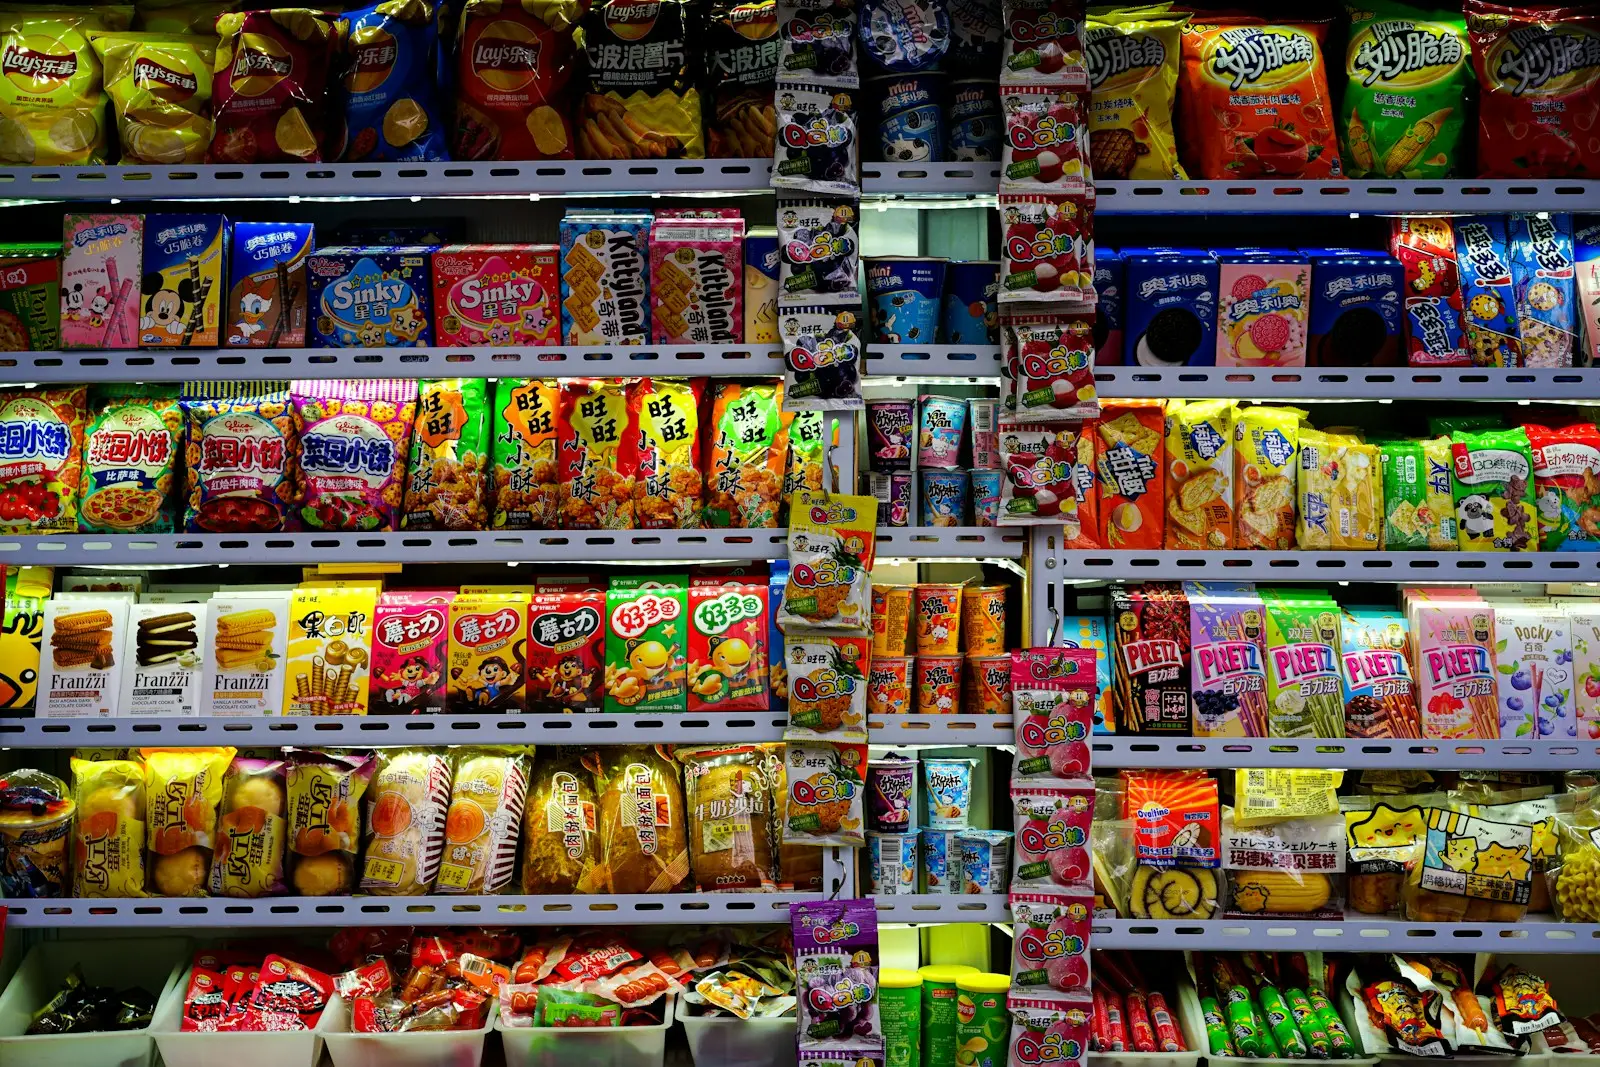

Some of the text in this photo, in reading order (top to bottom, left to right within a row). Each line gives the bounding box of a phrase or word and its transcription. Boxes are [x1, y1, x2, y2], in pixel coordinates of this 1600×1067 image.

[1220, 27, 1264, 46] BUGLES
[1373, 22, 1416, 40] BUGLES
[3, 49, 77, 76] Lay's 乐事
[475, 44, 511, 64] Lay's
[585, 42, 685, 70] 大波浪薯片
[1217, 33, 1313, 89] 妙脆角
[1356, 33, 1461, 88] 妙脆角
[888, 80, 918, 97] mini
[76, 223, 128, 246] 奥利奥
[155, 223, 209, 246] 奥利奥
[164, 235, 204, 255] 巧脆卷
[244, 230, 299, 253] 奥利奥
[1008, 233, 1075, 262] QQ糖
[253, 242, 294, 262] 巧脆卷
[786, 237, 852, 264] QQ糖
[333, 281, 404, 310] Sinky
[460, 280, 535, 308] Sinky
[607, 235, 648, 337] Kittyland
[1137, 273, 1209, 300] 奥利奥
[1322, 273, 1394, 299] 奥利奥
[29, 287, 49, 325] Pop
[354, 302, 388, 320] 星奇
[482, 301, 518, 319] 星奇
[697, 254, 738, 345] Kittyland
[1229, 295, 1301, 322] 奥利奥
[789, 345, 855, 372] QQ糖
[1024, 350, 1088, 380] QQ糖
[422, 390, 452, 437] 旺旺
[515, 386, 554, 436] 旺旺
[580, 394, 618, 444] 旺旺
[648, 394, 690, 443] 旺旺
[731, 400, 766, 444] 旺旺
[90, 431, 169, 464] 菜园小饼
[203, 436, 286, 471] 菜园小饼
[303, 435, 394, 474] 菜园小饼
[1191, 424, 1217, 459] 闲趣
[1263, 432, 1287, 465] 闲趣
[498, 423, 539, 495] 小小酥
[563, 430, 601, 503] 小小酥
[637, 430, 676, 500] 小小酥
[713, 431, 746, 496] 小小酥
[1137, 455, 1155, 483] Tiki
[1547, 453, 1600, 469] 动物饼干
[105, 470, 140, 482] 比萨味
[210, 478, 260, 491] 红烩牛肉味
[316, 477, 364, 490] 孜然烧烤味
[1011, 461, 1072, 488] QQ糖
[810, 507, 857, 524] QQ糖
[809, 544, 830, 554] 旺仔
[793, 563, 856, 588] QQ糖
[297, 611, 367, 639] 黑白配
[616, 598, 676, 634] 好多鱼
[698, 595, 758, 630] 好多鱼
[384, 612, 440, 644] 蘑古力
[460, 611, 515, 643] 蘑古力
[538, 611, 595, 643] 蘑古力
[1288, 628, 1313, 640] 双层
[1441, 629, 1467, 642] 双层
[807, 654, 827, 664] 旺仔
[1124, 642, 1179, 671] PRETZ
[1524, 642, 1544, 653] 百奇
[1199, 646, 1260, 679] PRETZ
[1275, 646, 1336, 679] PRETZ
[1346, 651, 1407, 683] PRETZ
[1429, 647, 1490, 683] PRETZ
[51, 673, 106, 690] Franzzi
[134, 671, 189, 688] Franzzi
[214, 673, 269, 690] Franzzi
[794, 676, 856, 701] QQ糖
[1147, 668, 1180, 684] 百力滋
[1222, 678, 1260, 696] 百力滋
[1299, 680, 1338, 697] 百力滋
[1164, 694, 1185, 704] 十三香
[1372, 681, 1410, 698] 百力滋
[1453, 680, 1492, 699] 百力滋
[1034, 700, 1055, 709] 旺仔
[1144, 689, 1160, 722] 夜宵
[1164, 704, 1186, 714] 小龙虾
[1022, 720, 1086, 748] QQ糖
[806, 759, 827, 768] 旺仔
[793, 779, 855, 805] QQ糖
[695, 797, 765, 821] 牛奶沙拉
[1033, 805, 1055, 815] 旺仔
[1136, 807, 1170, 820] Ovaltine
[1021, 828, 1085, 854] QQ糖
[1032, 914, 1055, 923] 旺仔
[813, 922, 860, 944] QQ糖
[1020, 935, 1084, 961] QQ糖
[809, 983, 872, 1012] QQ糖
[1030, 1018, 1052, 1027] 旺仔
[1016, 1038, 1080, 1063] QQ糖
